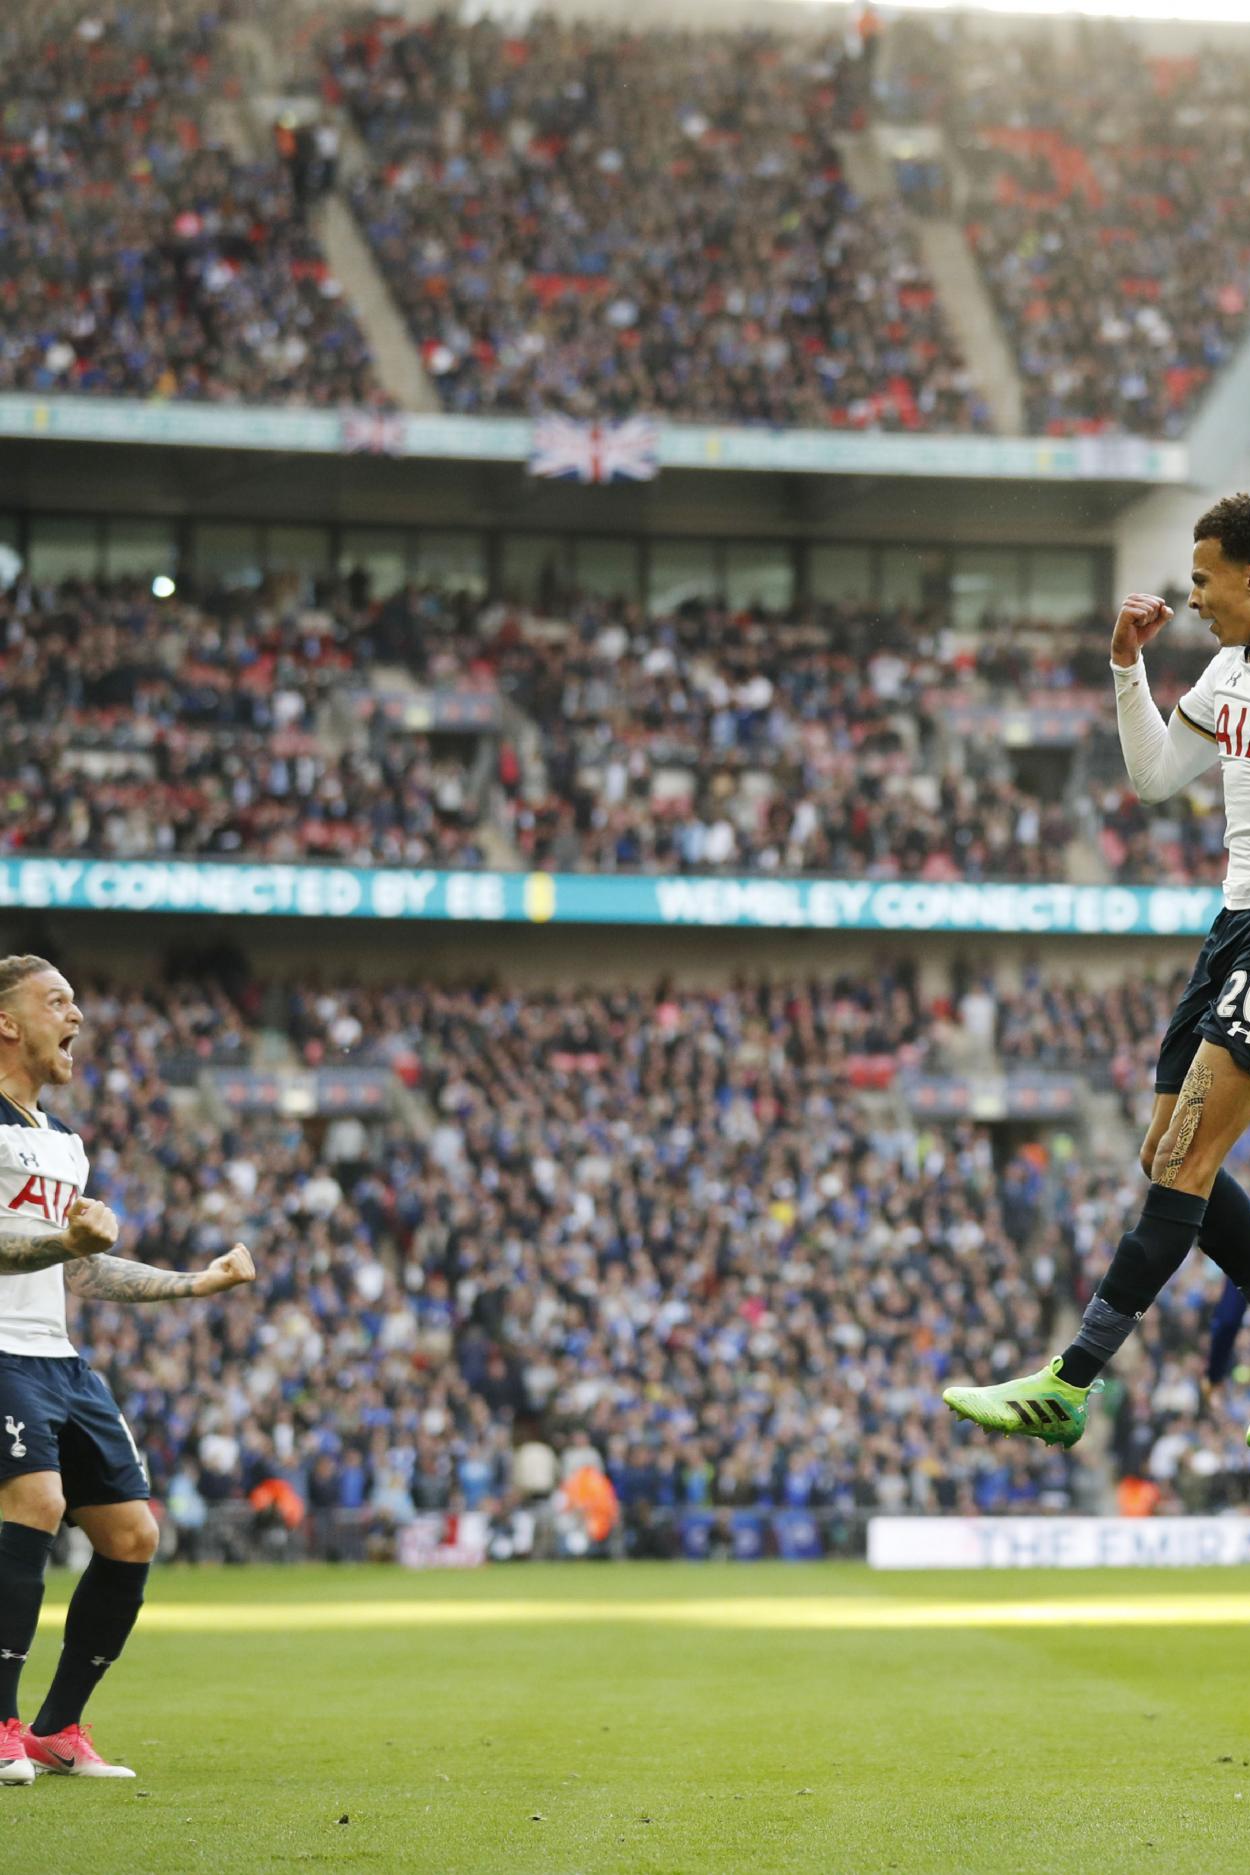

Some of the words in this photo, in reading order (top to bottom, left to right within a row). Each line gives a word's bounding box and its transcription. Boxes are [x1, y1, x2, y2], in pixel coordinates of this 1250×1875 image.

[84, 860, 361, 915] CONNECTED
[372, 867, 437, 919] BY
[444, 872, 504, 921] EE
[655, 880, 869, 928] WEMBLEY
[872, 881, 1140, 933] CONNECTED
[1147, 887, 1219, 935] BY
[981, 1524, 1070, 1563] THE
